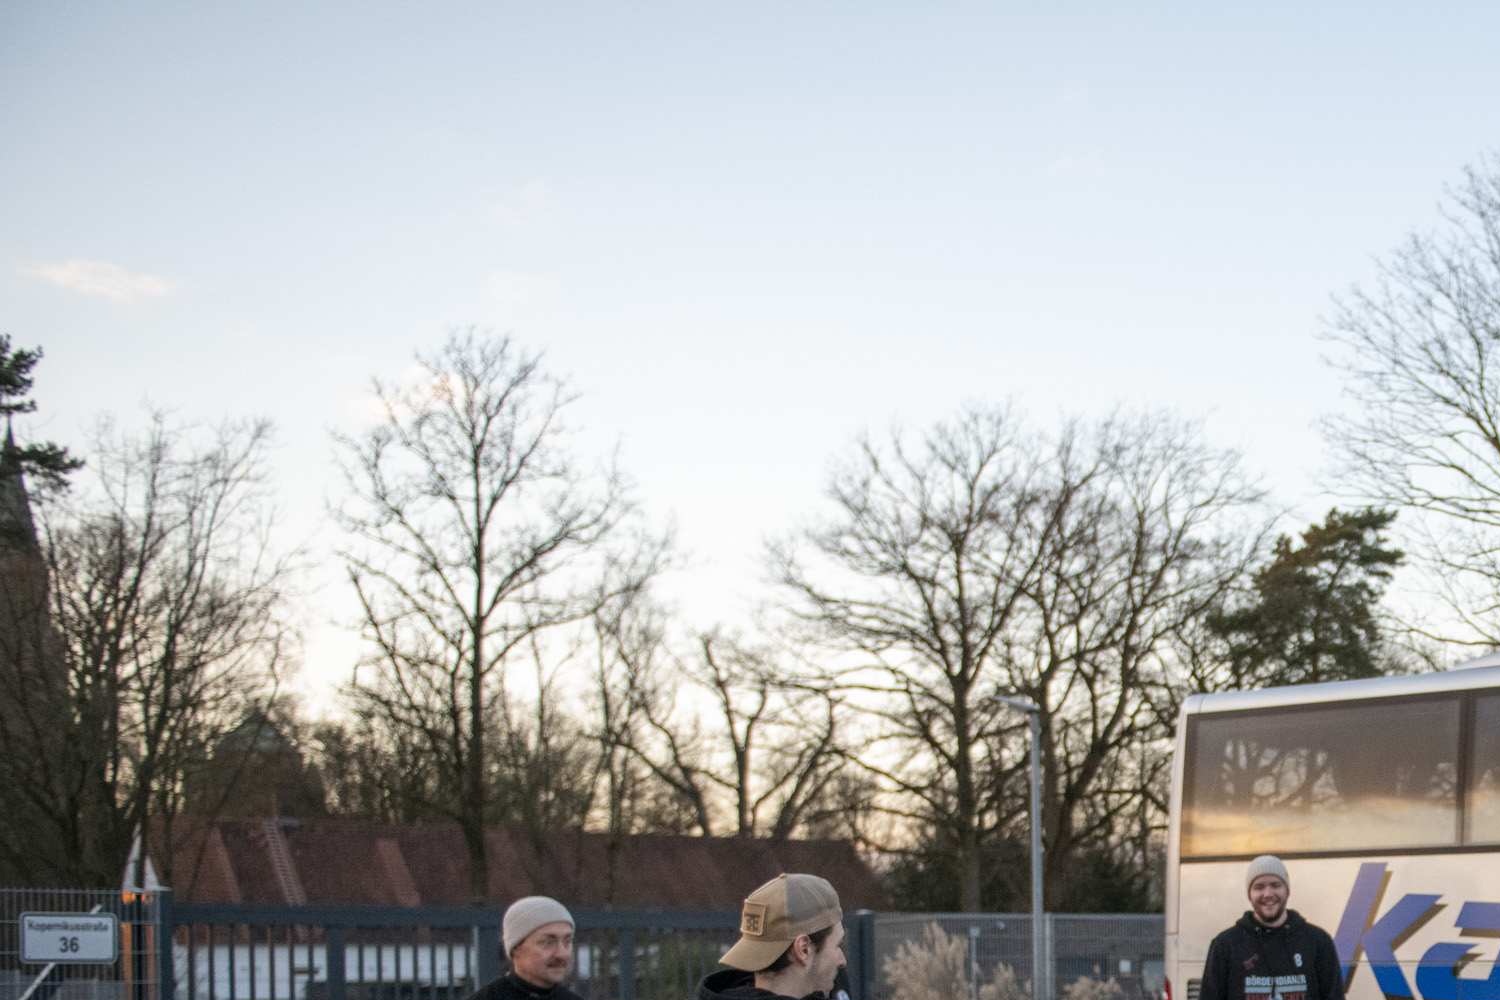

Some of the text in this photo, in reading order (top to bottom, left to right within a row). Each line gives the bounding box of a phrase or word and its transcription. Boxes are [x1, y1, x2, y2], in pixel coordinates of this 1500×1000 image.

[27, 921, 109, 933] Kopernikusstraße
[59, 936, 79, 953] 36
[1294, 953, 1303, 968] 8
